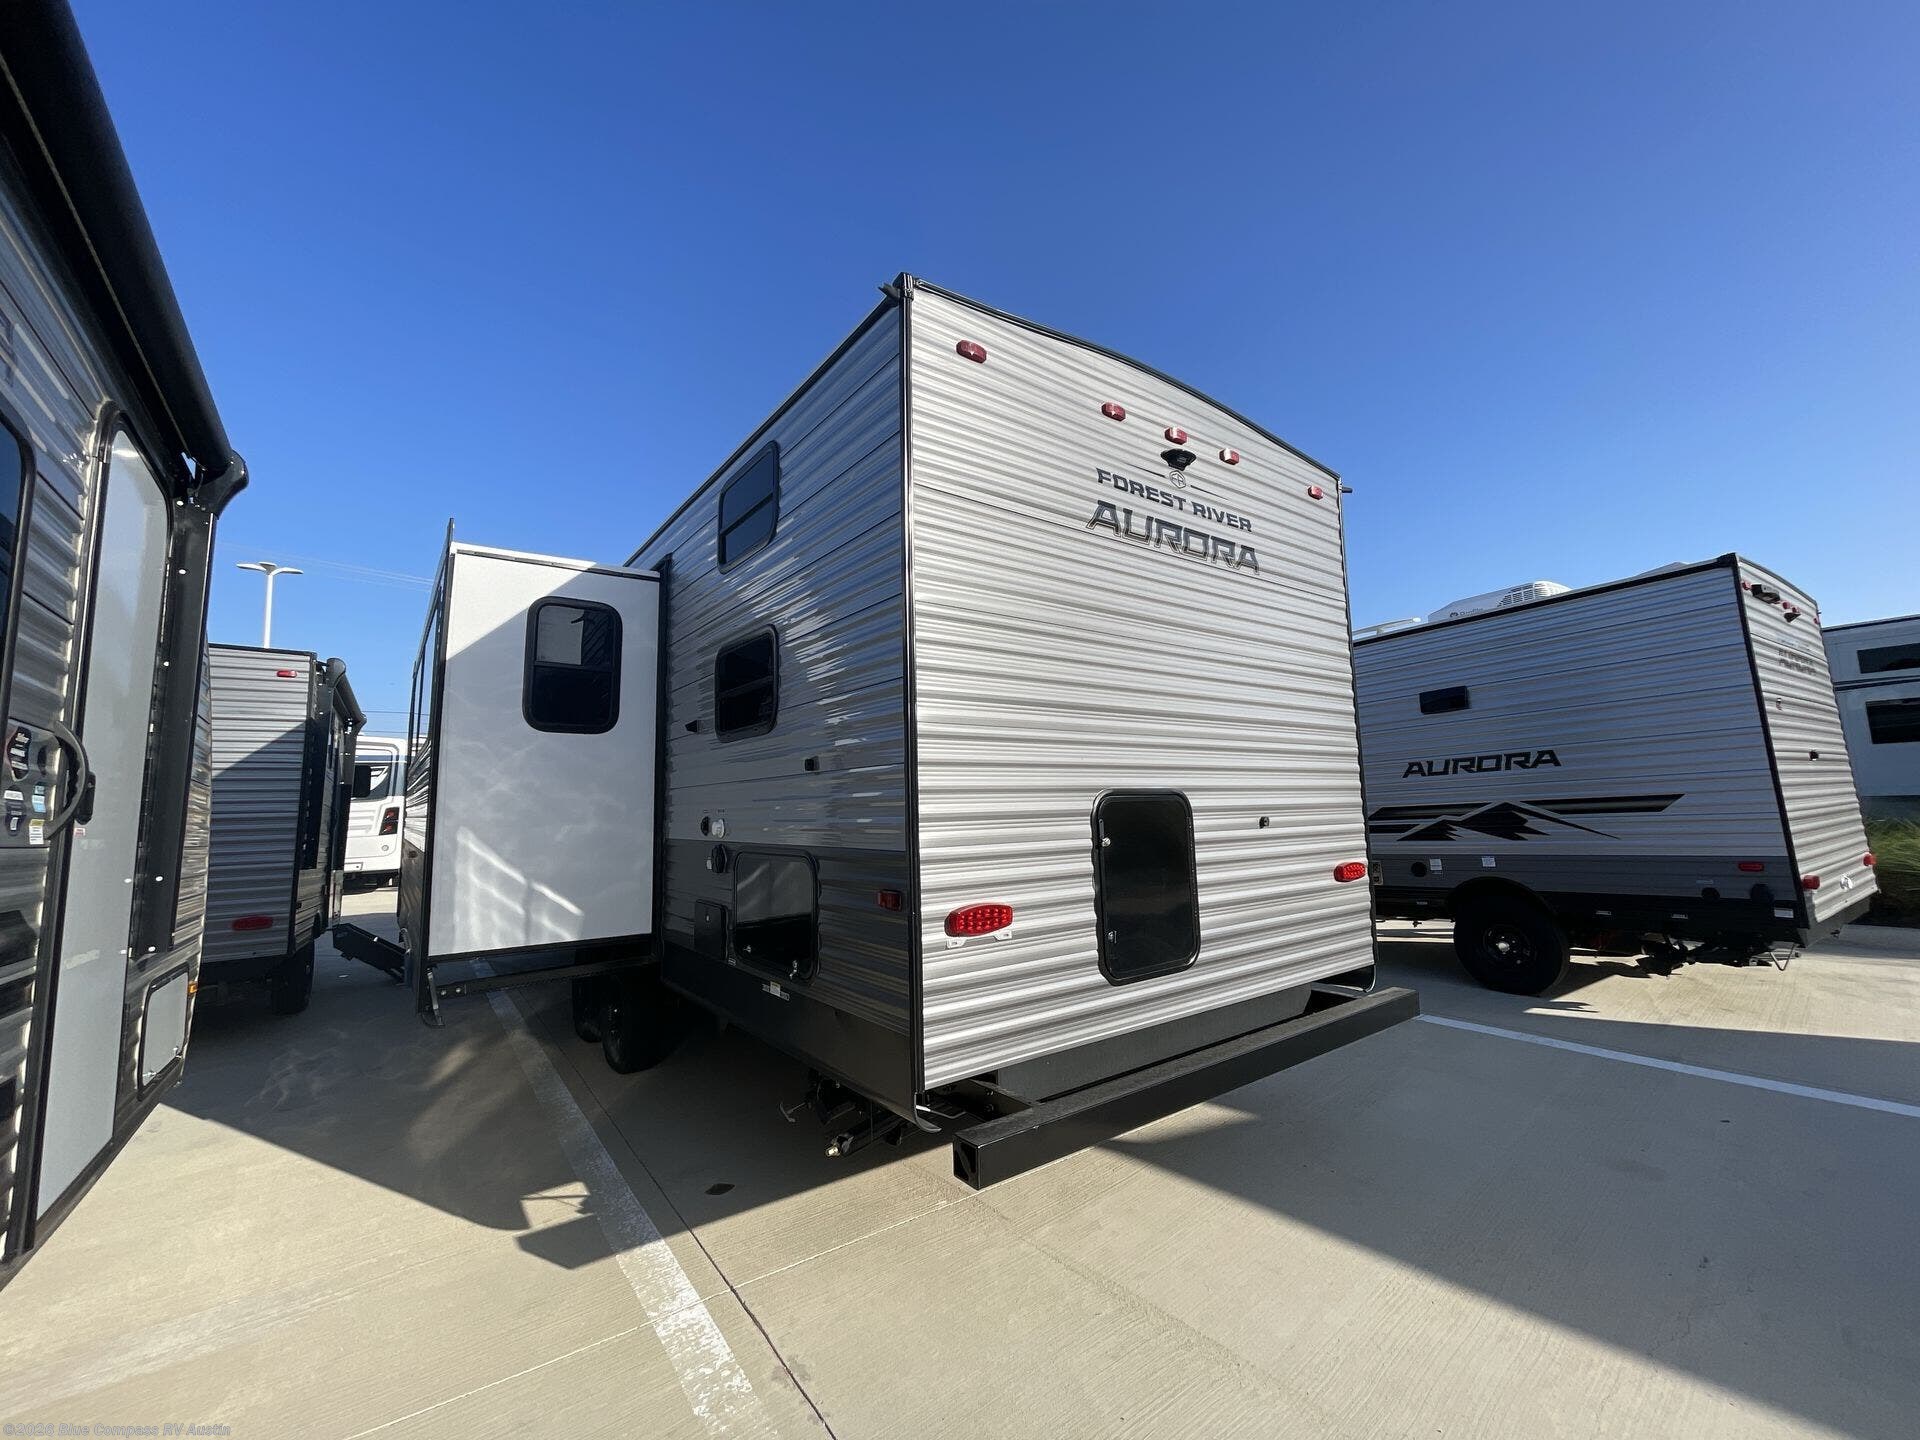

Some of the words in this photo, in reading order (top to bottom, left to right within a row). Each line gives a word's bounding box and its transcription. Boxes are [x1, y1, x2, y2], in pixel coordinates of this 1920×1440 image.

[1096, 467, 1187, 511] FOREST
[1192, 501, 1252, 532] RIVER
[1086, 499, 1260, 575] AURORA
[1402, 749, 1562, 779] AURORA
